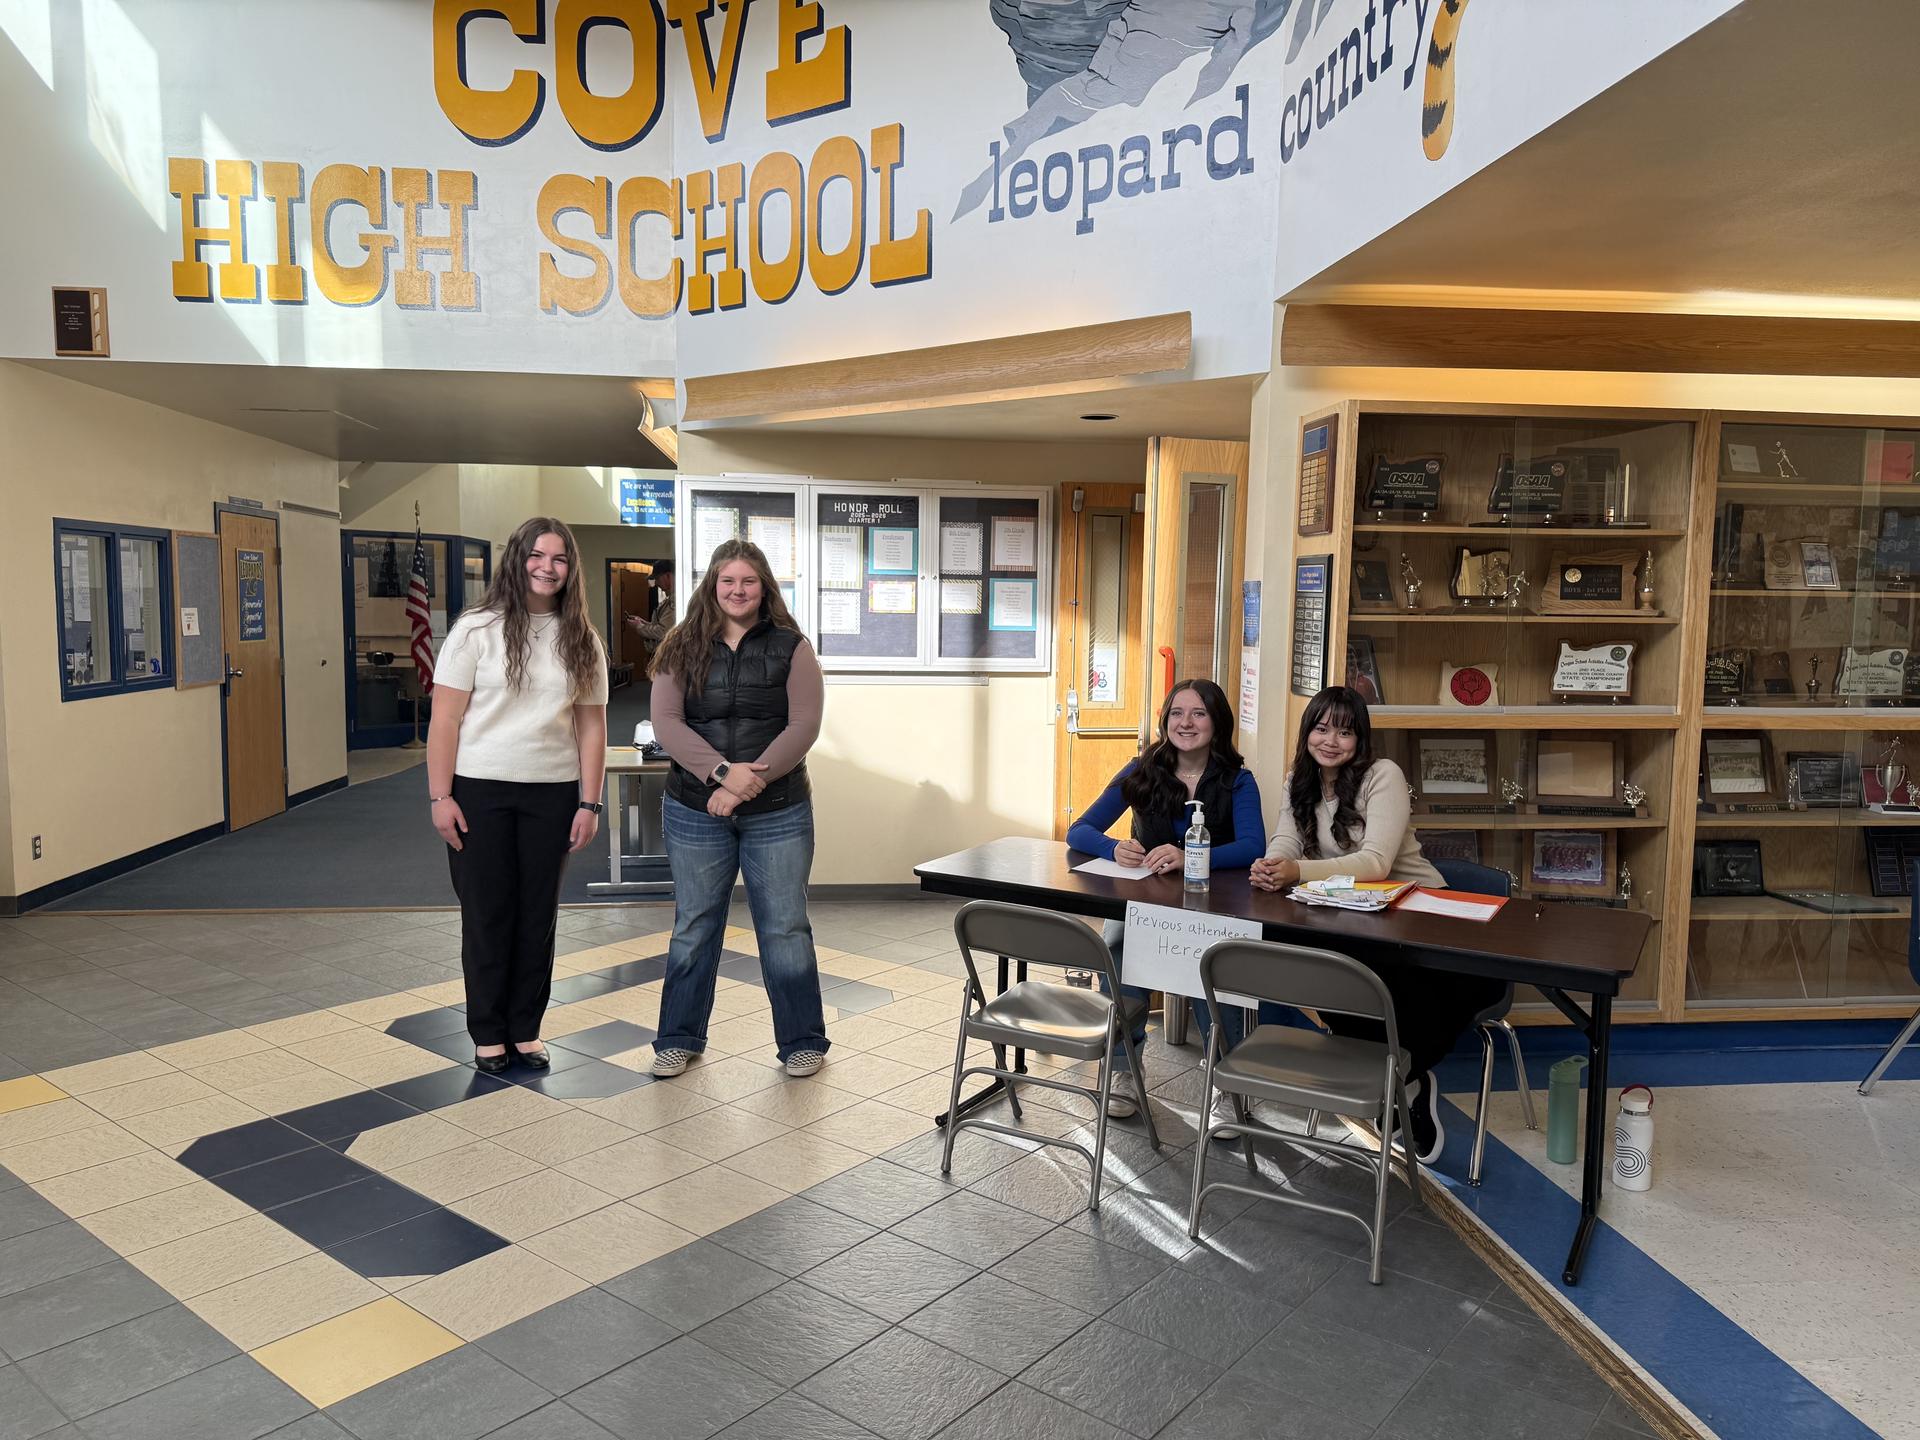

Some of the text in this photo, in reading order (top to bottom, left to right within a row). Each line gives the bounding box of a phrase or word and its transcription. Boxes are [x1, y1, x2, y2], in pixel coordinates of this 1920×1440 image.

[433, 0, 851, 152] COVE
[988, 0, 1428, 235] leopard country
[167, 122, 932, 321] HIGH SCHOOL
[1388, 471, 1425, 486] OSAA
[1514, 474, 1551, 488] OSAA
[834, 502, 903, 514] HONOR ROLL
[1129, 906, 1182, 932] Previous
[1158, 935, 1202, 960] Here
